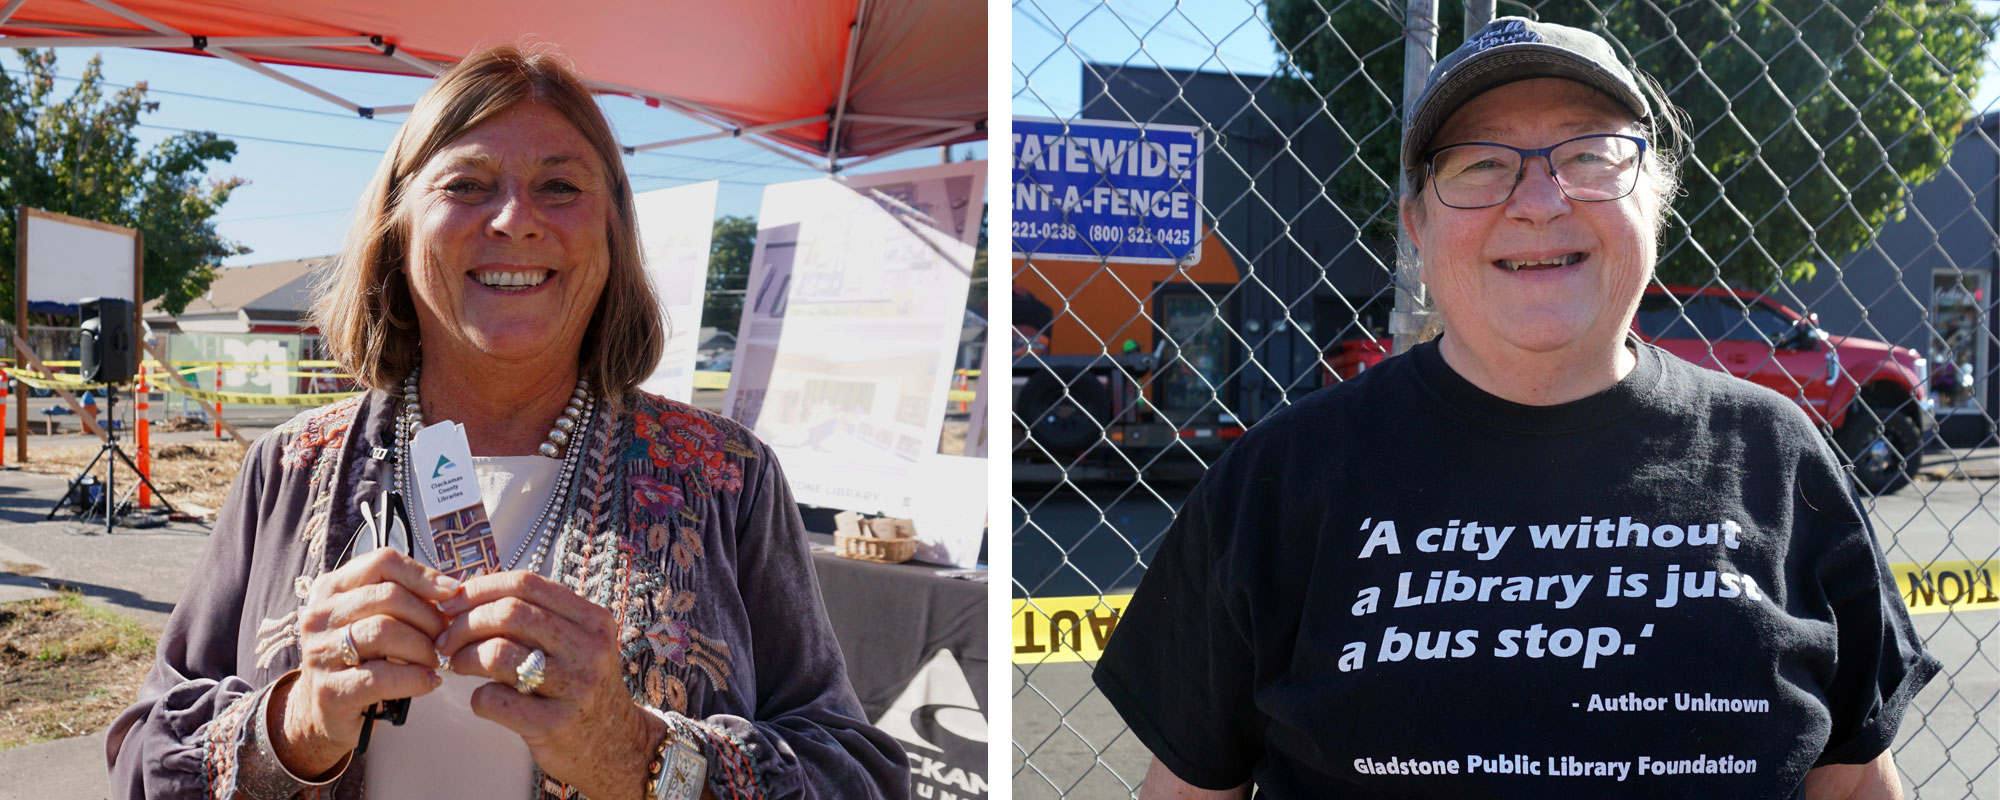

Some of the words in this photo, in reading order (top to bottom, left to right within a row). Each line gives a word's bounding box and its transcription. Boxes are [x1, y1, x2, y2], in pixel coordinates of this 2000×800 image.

[1012, 183, 1189, 219] NT-A-FENCE
[1012, 221, 1077, 240] 221-0238
[1089, 224, 1124, 243] (800)
[1127, 226, 1191, 245] 321-0425
[431, 476, 463, 490] Clackamas
[438, 485, 459, 495] County
[825, 487, 881, 501] LIBRARY
[437, 491, 463, 503] Libraries
[1415, 519, 1517, 561] city
[1528, 516, 1742, 550] without
[1352, 586, 1381, 617] a
[1394, 569, 1594, 610] Library
[1607, 566, 1649, 598] is
[1656, 564, 1763, 609] just
[1014, 608, 1121, 654] AUT
[1338, 641, 1366, 673] a
[1377, 626, 1479, 663] bus
[1587, 692, 1669, 713] Author
[1675, 692, 1770, 714] Unknown
[1354, 757, 1460, 776] Gladstone
[1467, 753, 1541, 776] Public
[1548, 755, 1632, 782] Library
[1638, 754, 1757, 775] Foundation
